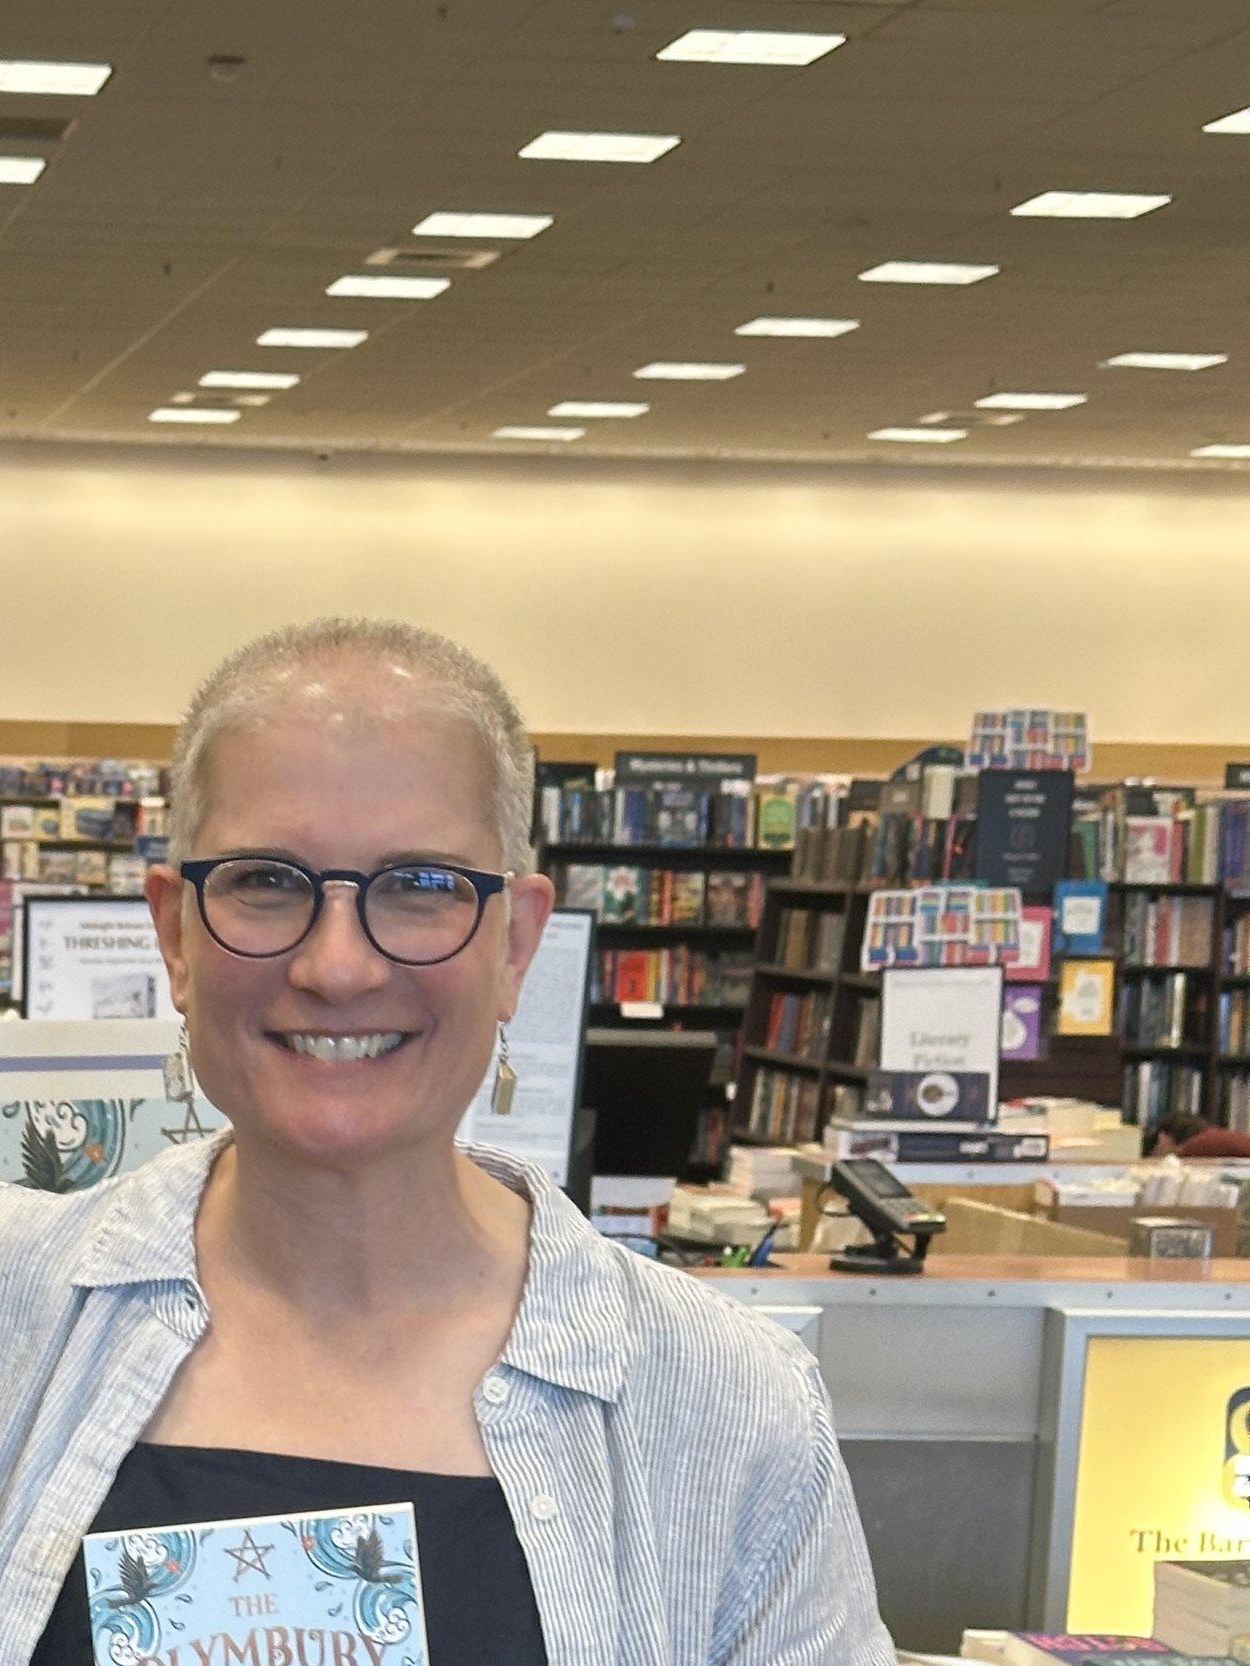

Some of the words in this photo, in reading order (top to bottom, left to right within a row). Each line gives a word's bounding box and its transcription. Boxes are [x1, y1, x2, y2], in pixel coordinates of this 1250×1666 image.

[63, 935, 151, 950] THRESHING
[1129, 1528, 1187, 1553] The
[227, 1592, 278, 1617] THE
